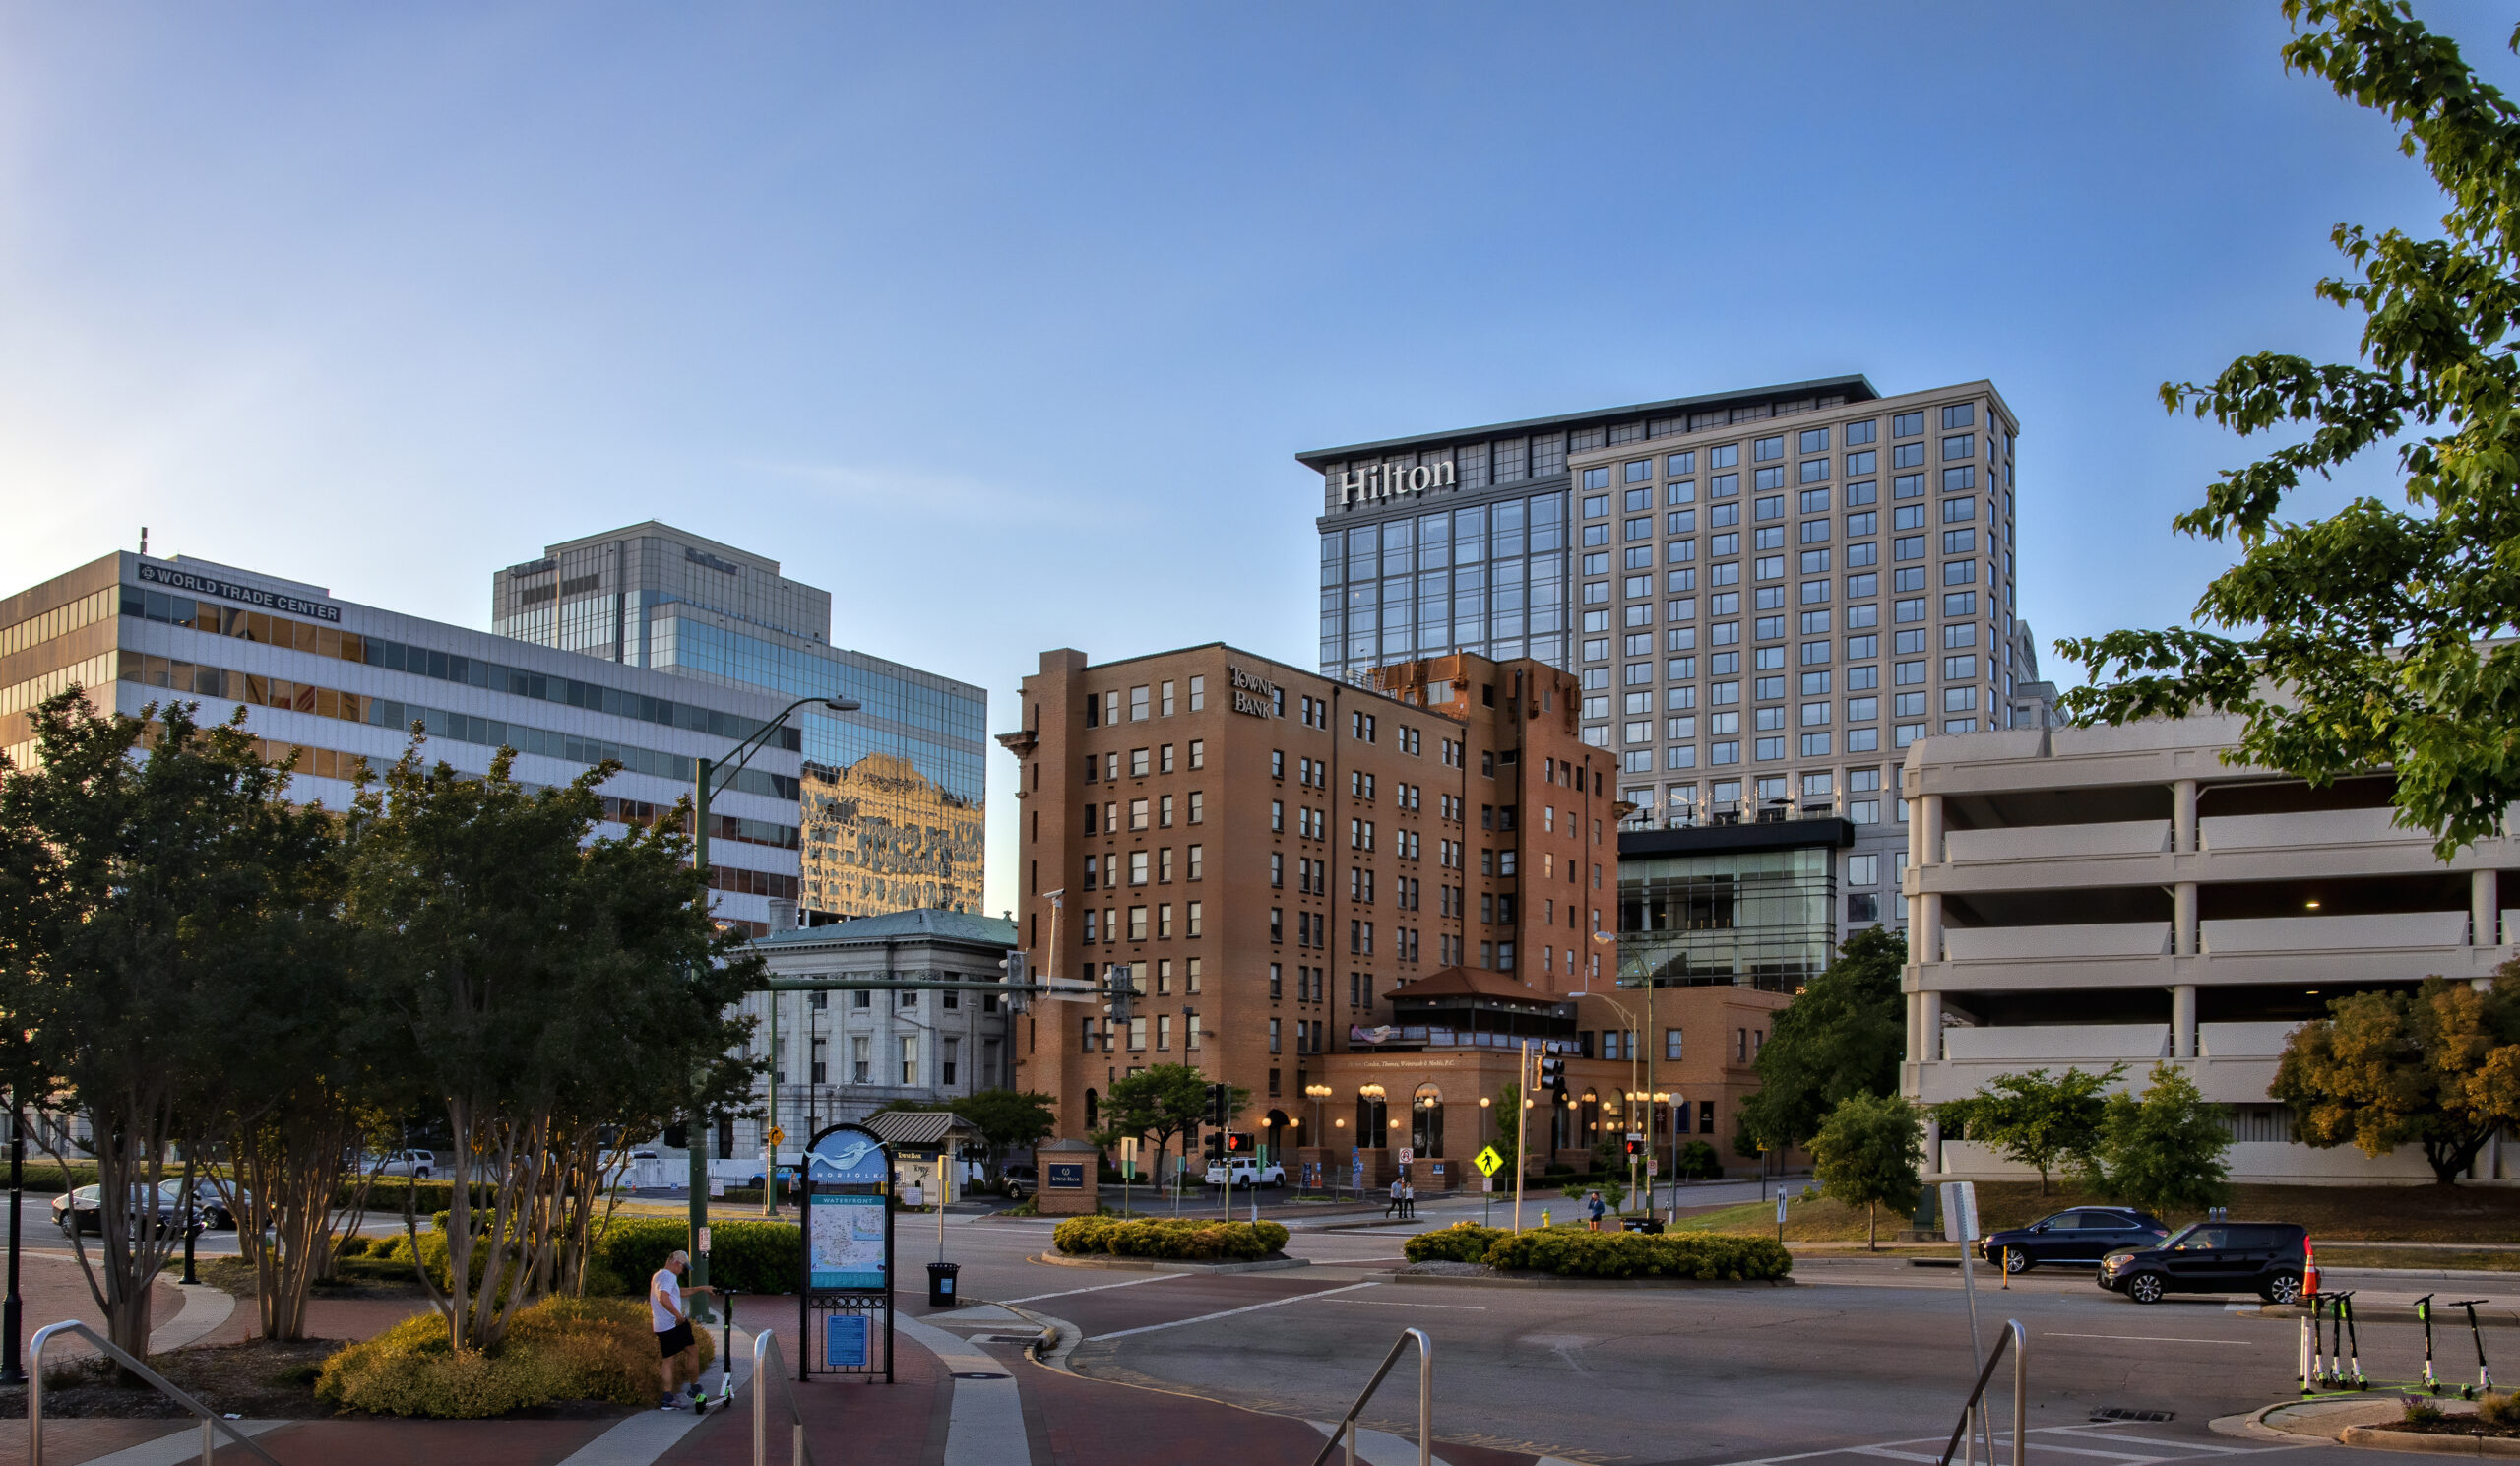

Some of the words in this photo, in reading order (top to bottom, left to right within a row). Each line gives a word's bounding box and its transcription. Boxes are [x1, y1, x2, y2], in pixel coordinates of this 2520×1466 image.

[1340, 460, 1456, 504] Hilton
[157, 568, 217, 593] WORLD
[220, 583, 274, 606] TRADE
[277, 596, 338, 621] CENTER
[1230, 663, 1276, 697] TOWNE
[1234, 689, 1271, 719] BANK
